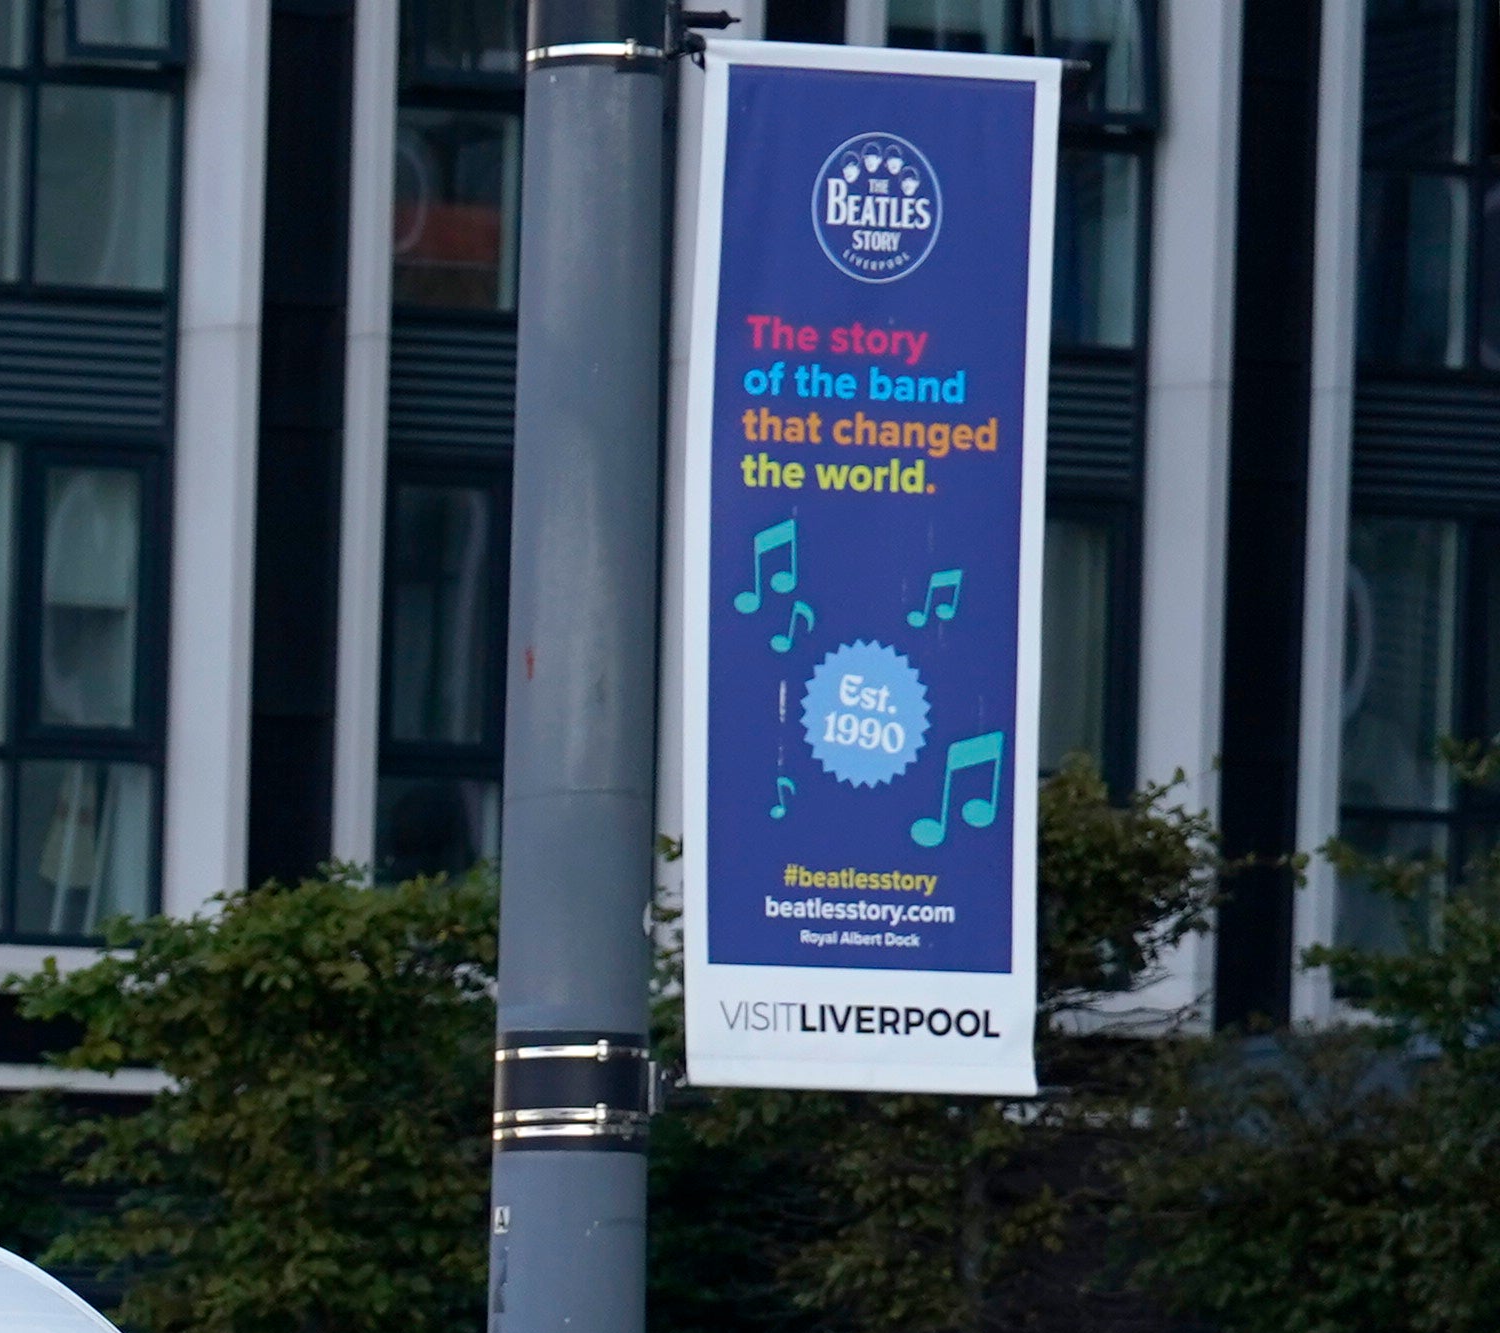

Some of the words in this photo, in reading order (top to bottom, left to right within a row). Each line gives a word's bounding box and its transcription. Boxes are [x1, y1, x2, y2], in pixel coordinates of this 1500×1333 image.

[826, 177, 932, 230] BEATLES
[868, 178, 889, 195] THE
[842, 248, 911, 271] LIVERPOOL
[851, 229, 902, 251] STORY
[747, 314, 820, 352] The
[830, 321, 929, 366] story
[743, 361, 786, 396] of
[794, 363, 857, 400] the
[869, 366, 966, 404] band
[741, 407, 822, 445] that
[832, 410, 999, 458] changed
[740, 452, 805, 489] the
[814, 456, 937, 495] world.
[839, 673, 898, 715] Est.
[822, 711, 906, 755] 1990
[783, 863, 938, 897] #beatlesstory
[764, 895, 957, 927] beatlesstory.com
[799, 929, 838, 947] Royal
[840, 931, 883, 946] Albert
[884, 932, 921, 948] Dock
